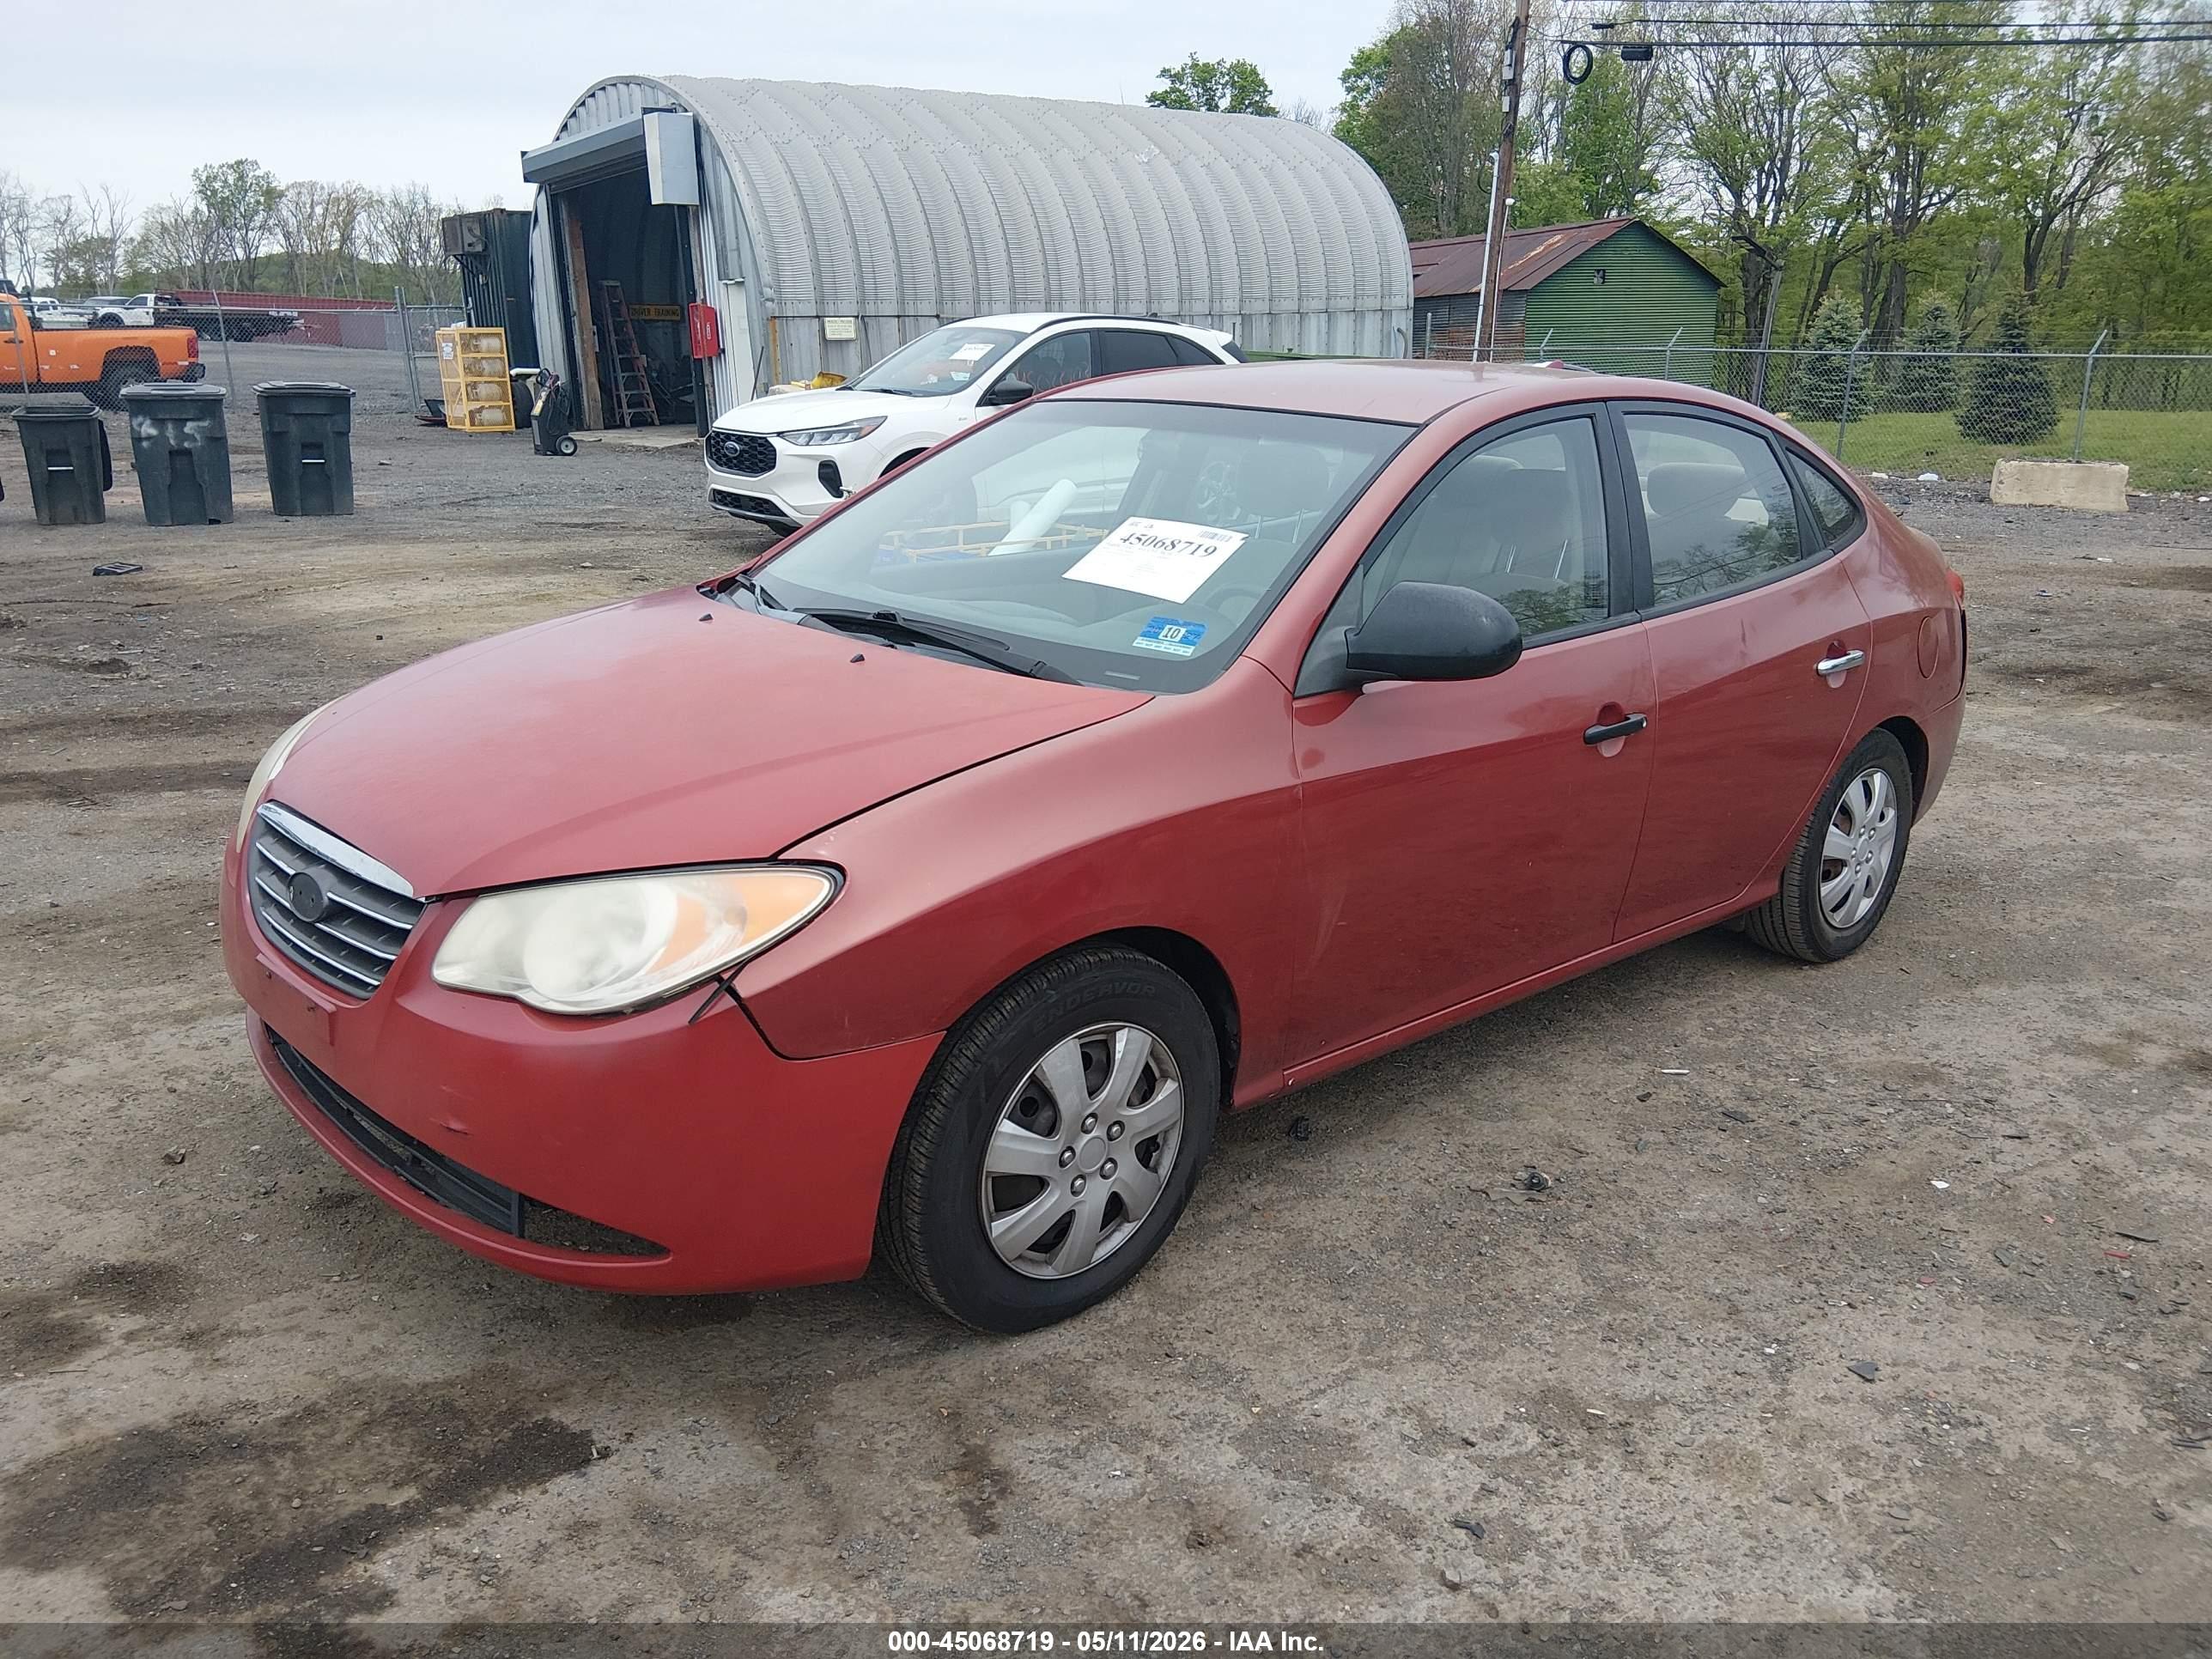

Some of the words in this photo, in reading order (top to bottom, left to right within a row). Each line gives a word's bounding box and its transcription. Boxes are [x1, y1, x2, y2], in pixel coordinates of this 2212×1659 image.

[653, 307, 679, 317] TRAINING
[1119, 532, 1218, 558] 45068719
[1162, 626, 1182, 640] 10
